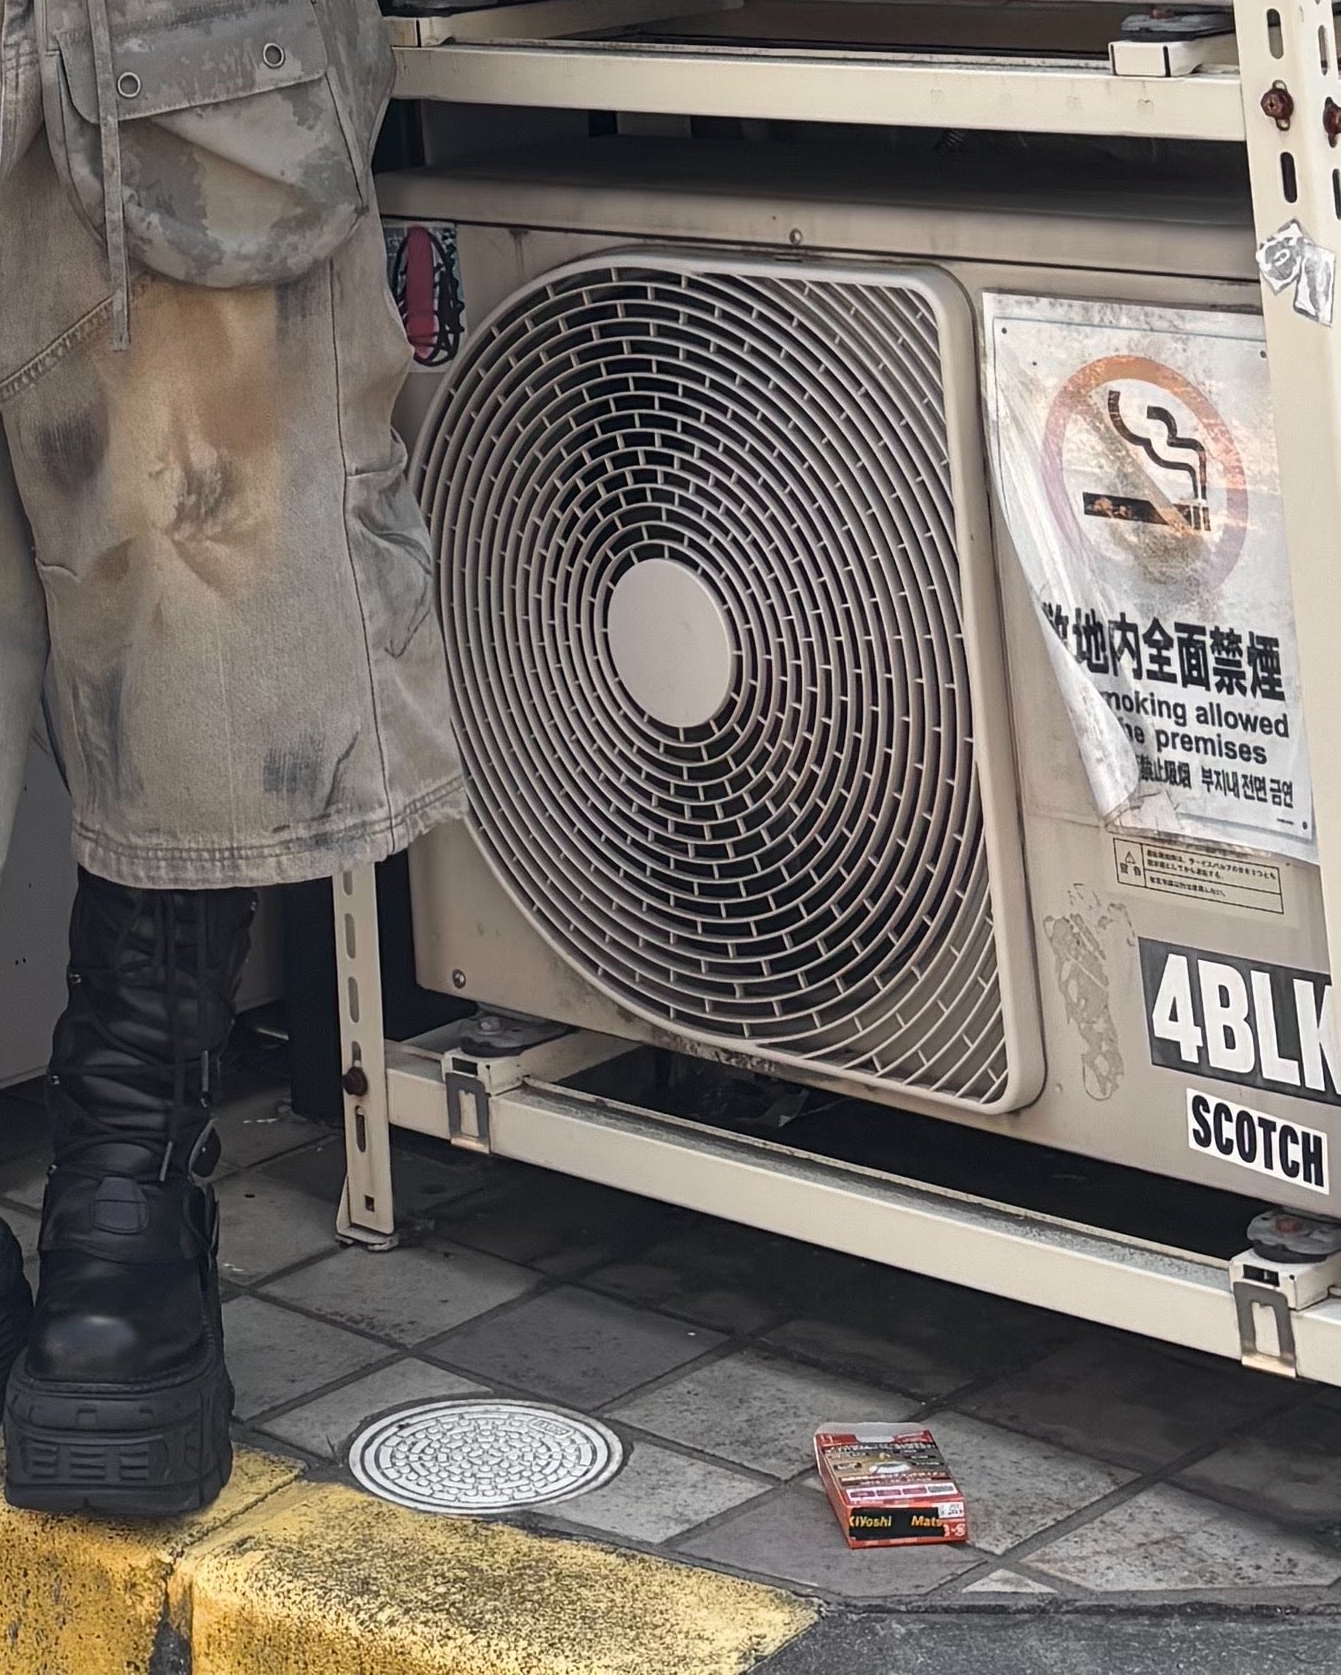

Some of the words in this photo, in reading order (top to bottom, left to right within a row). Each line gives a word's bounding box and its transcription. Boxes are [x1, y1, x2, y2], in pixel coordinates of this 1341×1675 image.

[1101, 690, 1188, 725] moking
[1195, 702, 1290, 739] allowed
[1155, 729, 1268, 765] premises
[1137, 754, 1192, 789] 禁止吸烟
[1241, 774, 1267, 803] 전면
[1269, 781, 1294, 808] 금연
[1152, 953, 1341, 1096] 4BLK
[1192, 1094, 1325, 1187] SCOTCH
